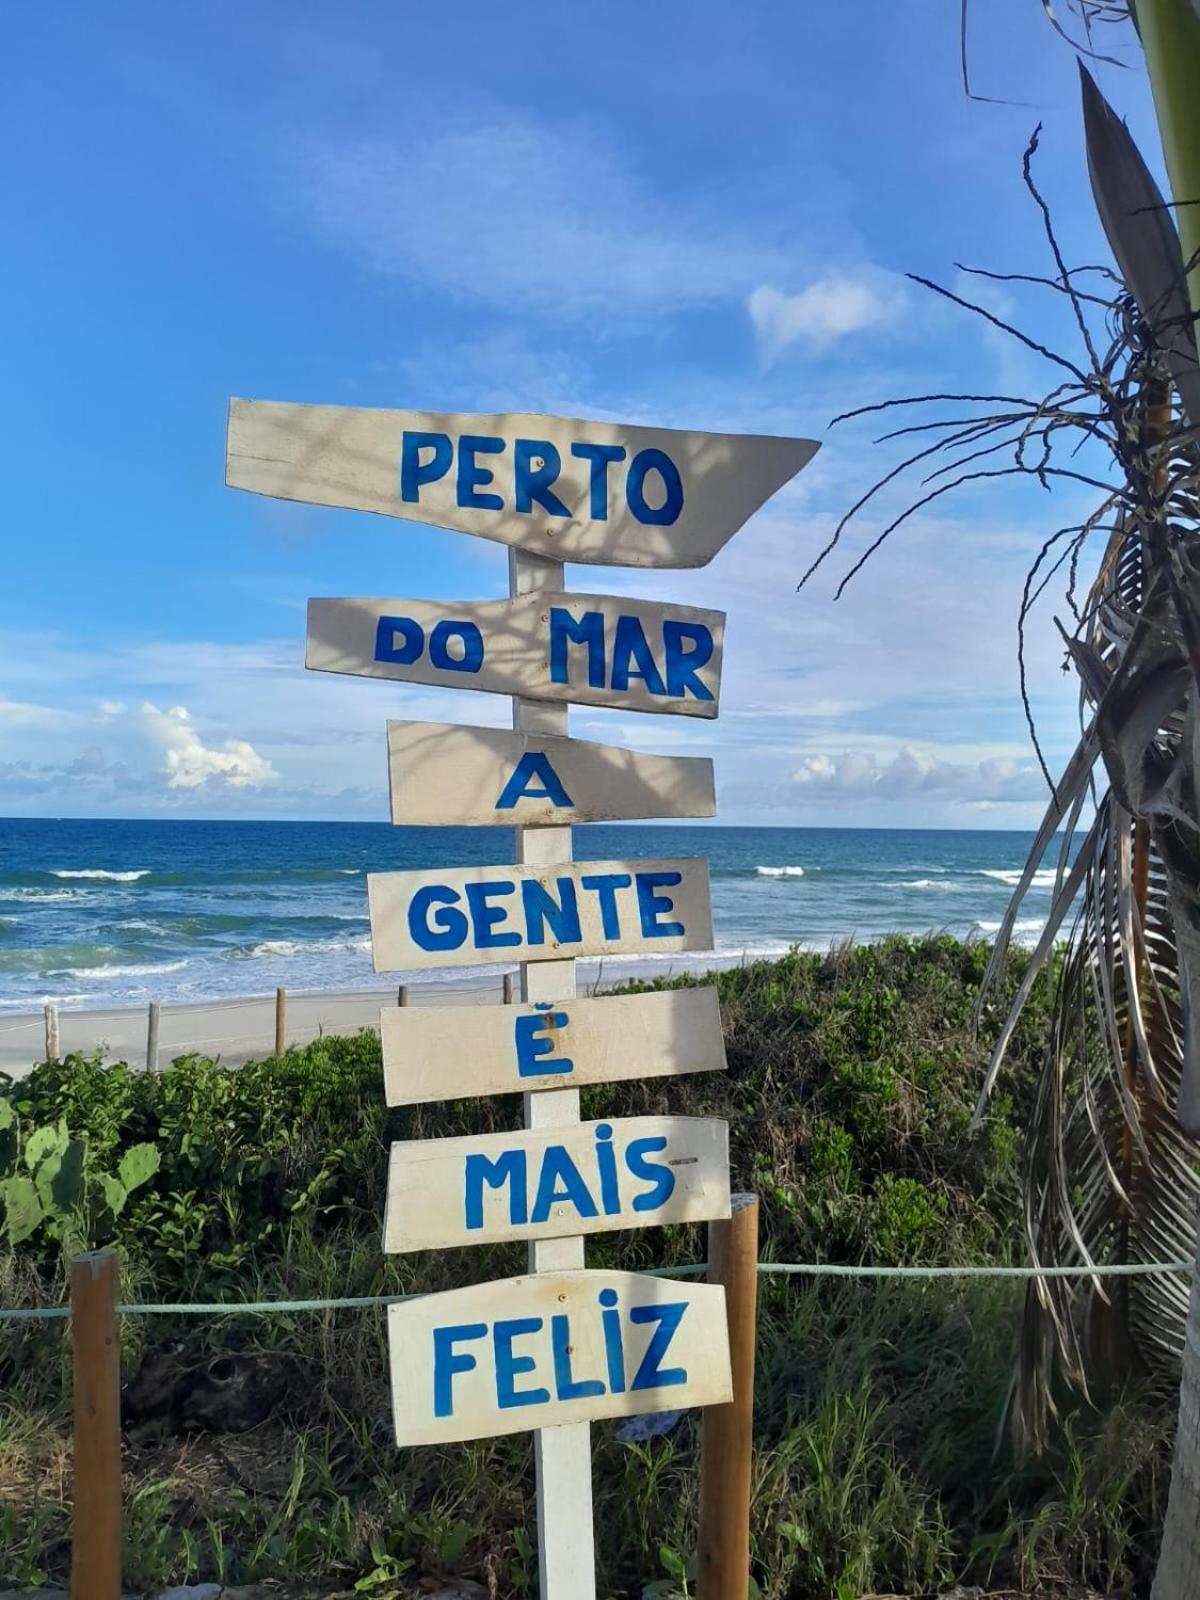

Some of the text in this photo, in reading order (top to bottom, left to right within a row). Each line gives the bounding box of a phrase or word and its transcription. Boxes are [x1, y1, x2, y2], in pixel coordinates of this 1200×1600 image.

[401, 431, 684, 525] PERTO
[374, 608, 714, 700] DO MAR
[496, 752, 574, 809] A
[408, 871, 685, 952] GENTE
